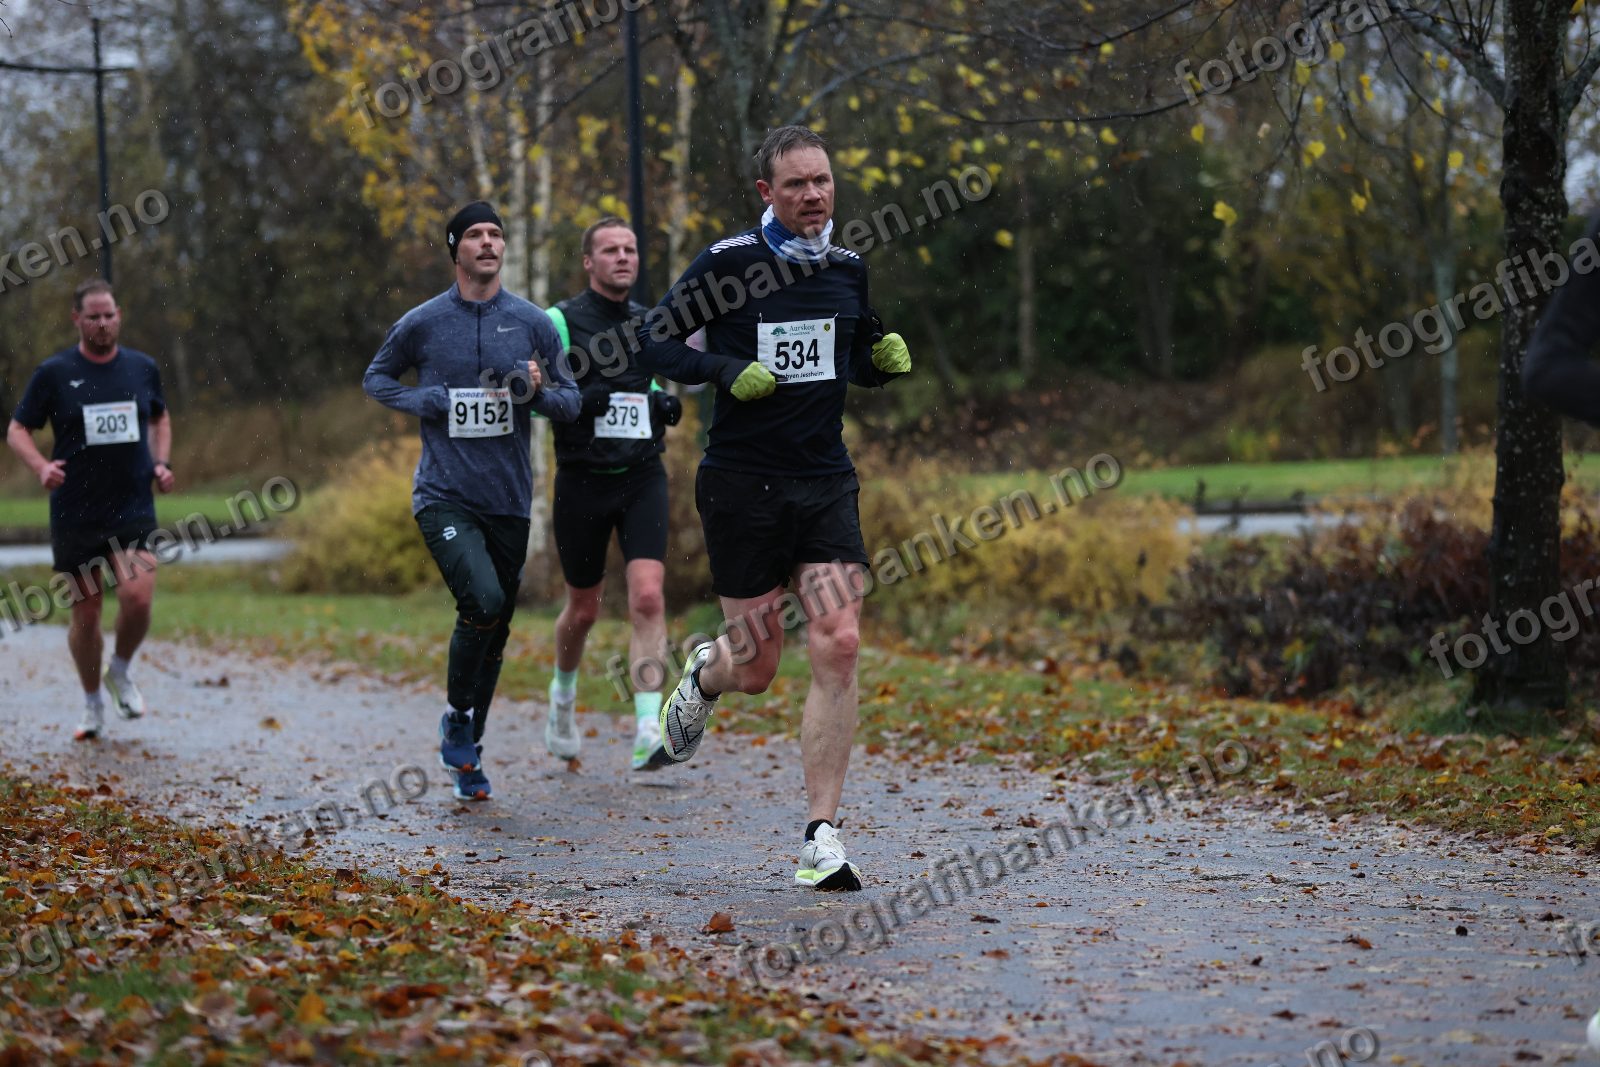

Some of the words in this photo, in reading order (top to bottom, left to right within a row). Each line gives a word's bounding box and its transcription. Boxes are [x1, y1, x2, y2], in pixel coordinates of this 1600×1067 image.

[790, 324, 816, 332] Aurskog
[774, 339, 820, 370] 534
[95, 413, 128, 434] 203
[455, 401, 509, 425] 9152
[606, 405, 639, 427] 379
